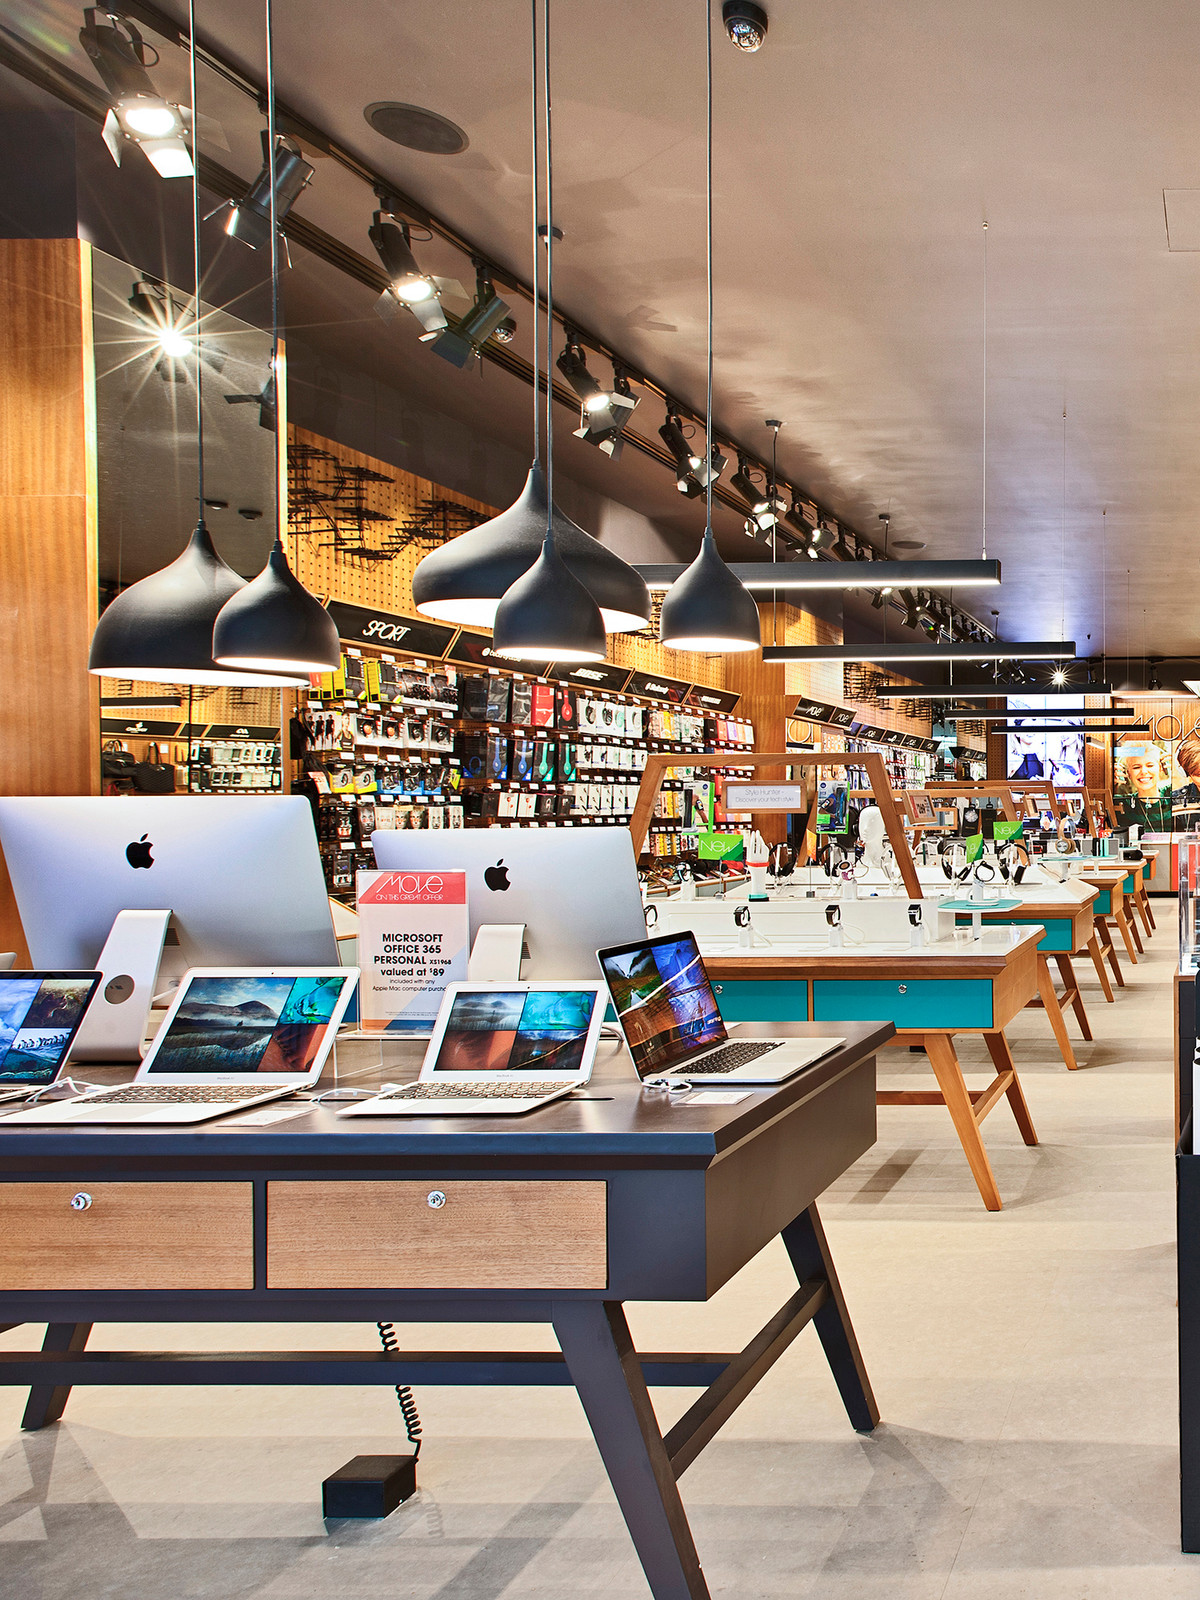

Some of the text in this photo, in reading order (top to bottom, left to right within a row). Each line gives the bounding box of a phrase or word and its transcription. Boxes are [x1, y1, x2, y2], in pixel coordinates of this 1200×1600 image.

[361, 619, 412, 642] SPORT
[382, 933, 443, 943] MICROSOFT
[383, 944, 442, 954] OFFICE 365
[374, 956, 427, 965] PERSONAL
[380, 968, 445, 977] valued at $89
